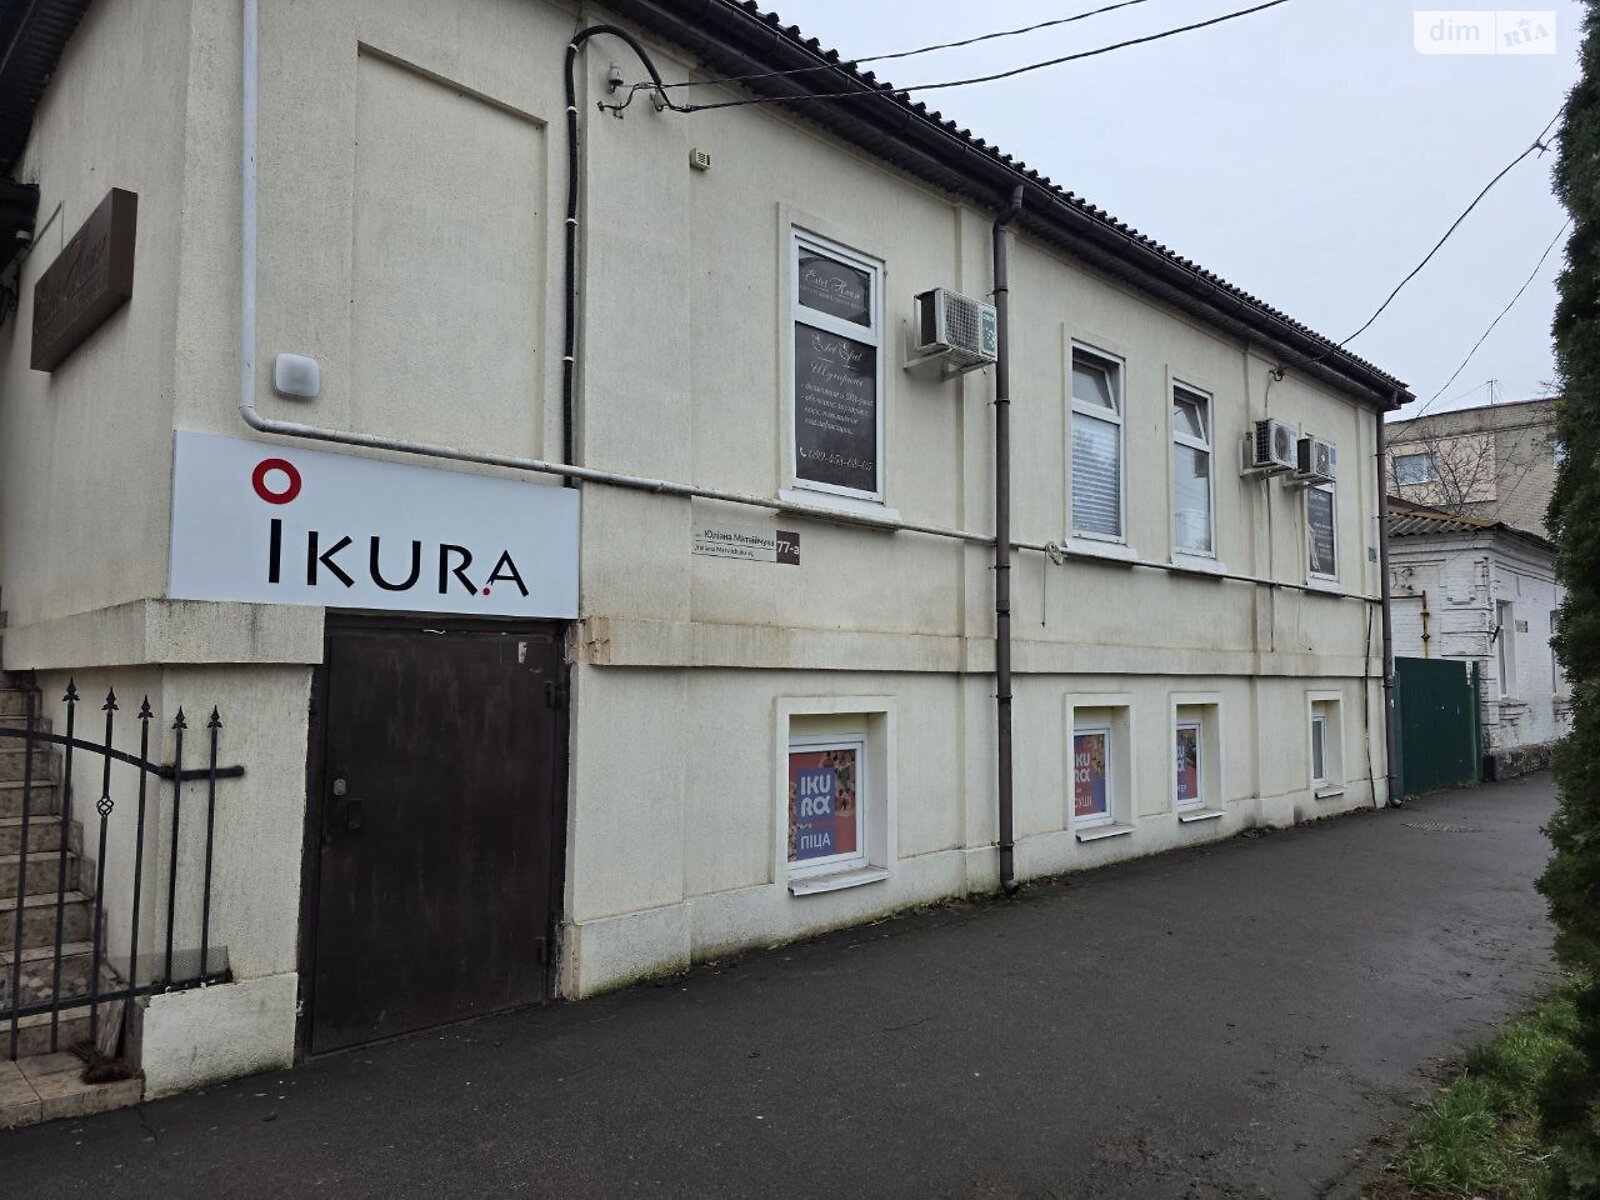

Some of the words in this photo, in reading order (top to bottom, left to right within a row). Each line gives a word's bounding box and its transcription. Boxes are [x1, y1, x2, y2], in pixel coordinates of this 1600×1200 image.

[268, 517, 530, 597] IKURA
[800, 774, 831, 796] IKU
[800, 832, 831, 850] ПІЦА
